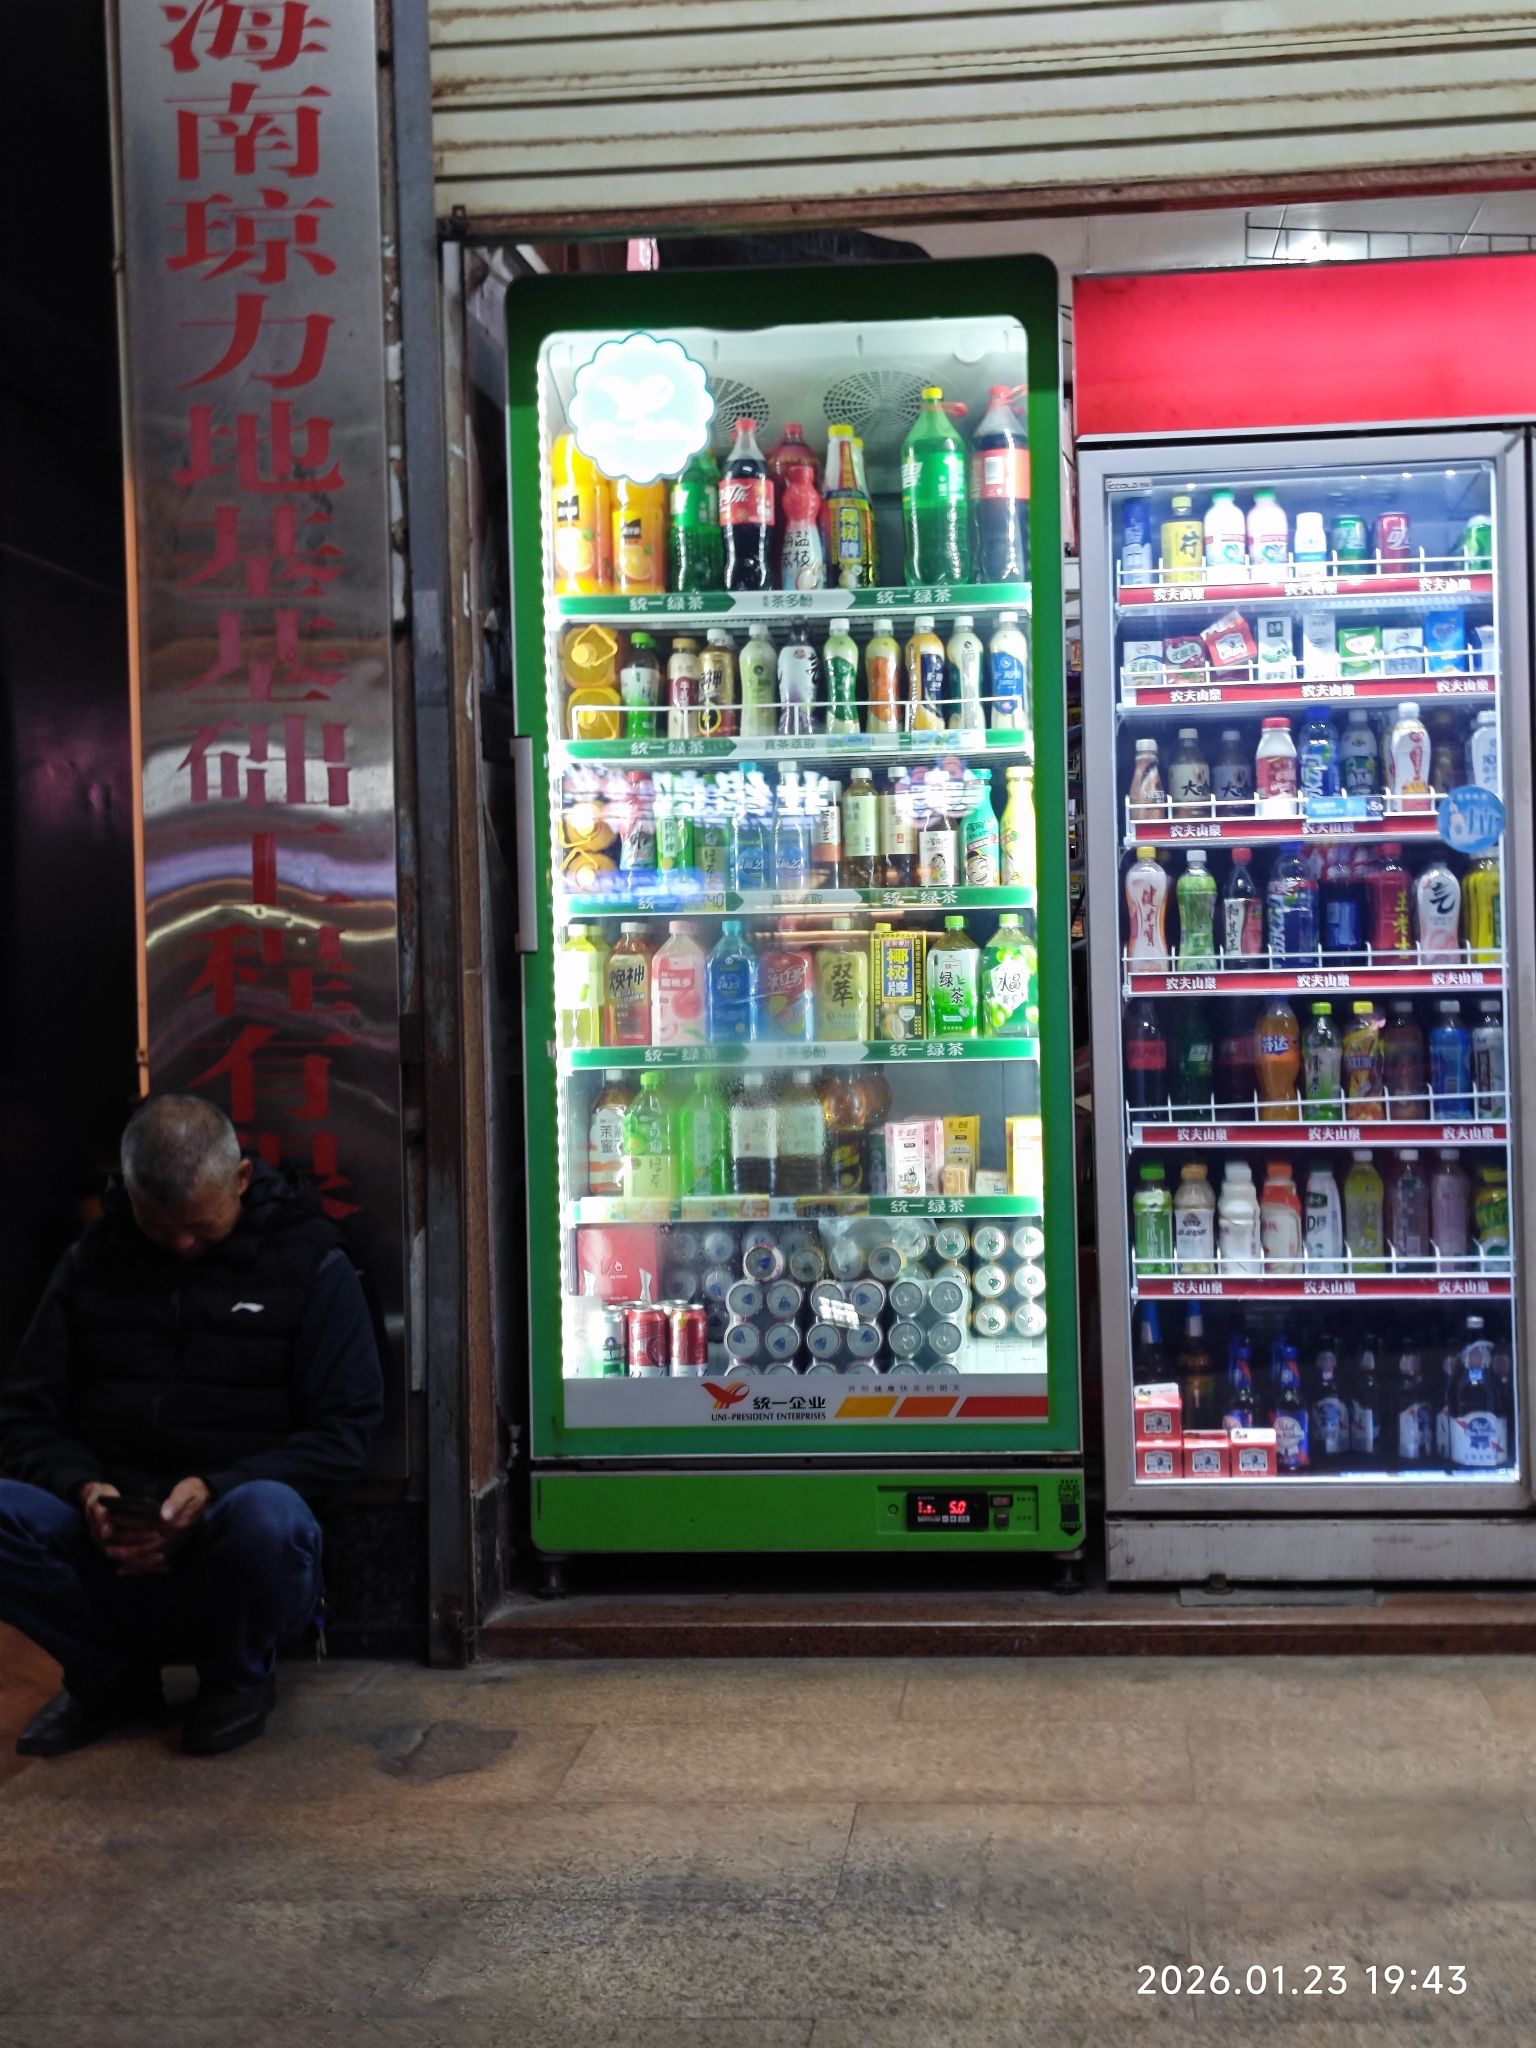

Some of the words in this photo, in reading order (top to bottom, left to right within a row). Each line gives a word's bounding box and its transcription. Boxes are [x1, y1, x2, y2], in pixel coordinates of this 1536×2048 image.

[629, 596, 704, 611] 统一绿茶
[876, 589, 952, 604] 统一绿茶
[1170, 689, 1222, 703] 农夫山泉
[631, 741, 704, 755] 统一绿茶
[1170, 824, 1222, 838] 农夫山泉
[883, 891, 958, 905] 统一绿茶
[886, 947, 909, 996] 椰树牌
[1432, 971, 1484, 985] 农夫山泉
[831, 963, 853, 1007] 双萃
[1166, 977, 1217, 990] 农夫山泉
[1297, 974, 1351, 988] 农夫山泉
[890, 1043, 964, 1057] 统一绿茶
[1177, 1128, 1228, 1141] 农夫山泉
[1308, 1127, 1361, 1141] 农夫山泉
[1443, 1126, 1495, 1140] 农夫山泉
[890, 1200, 965, 1213] 统一绿茶
[1173, 1281, 1224, 1295] 农夫山泉
[1304, 1281, 1357, 1295] 农夫山泉
[1438, 1281, 1490, 1295] 农夫山泉
[753, 1396, 827, 1410] 统一企业
[711, 1412, 774, 1421] UNI-PRESIDENT
[776, 1411, 827, 1421] ENTERPRISES
